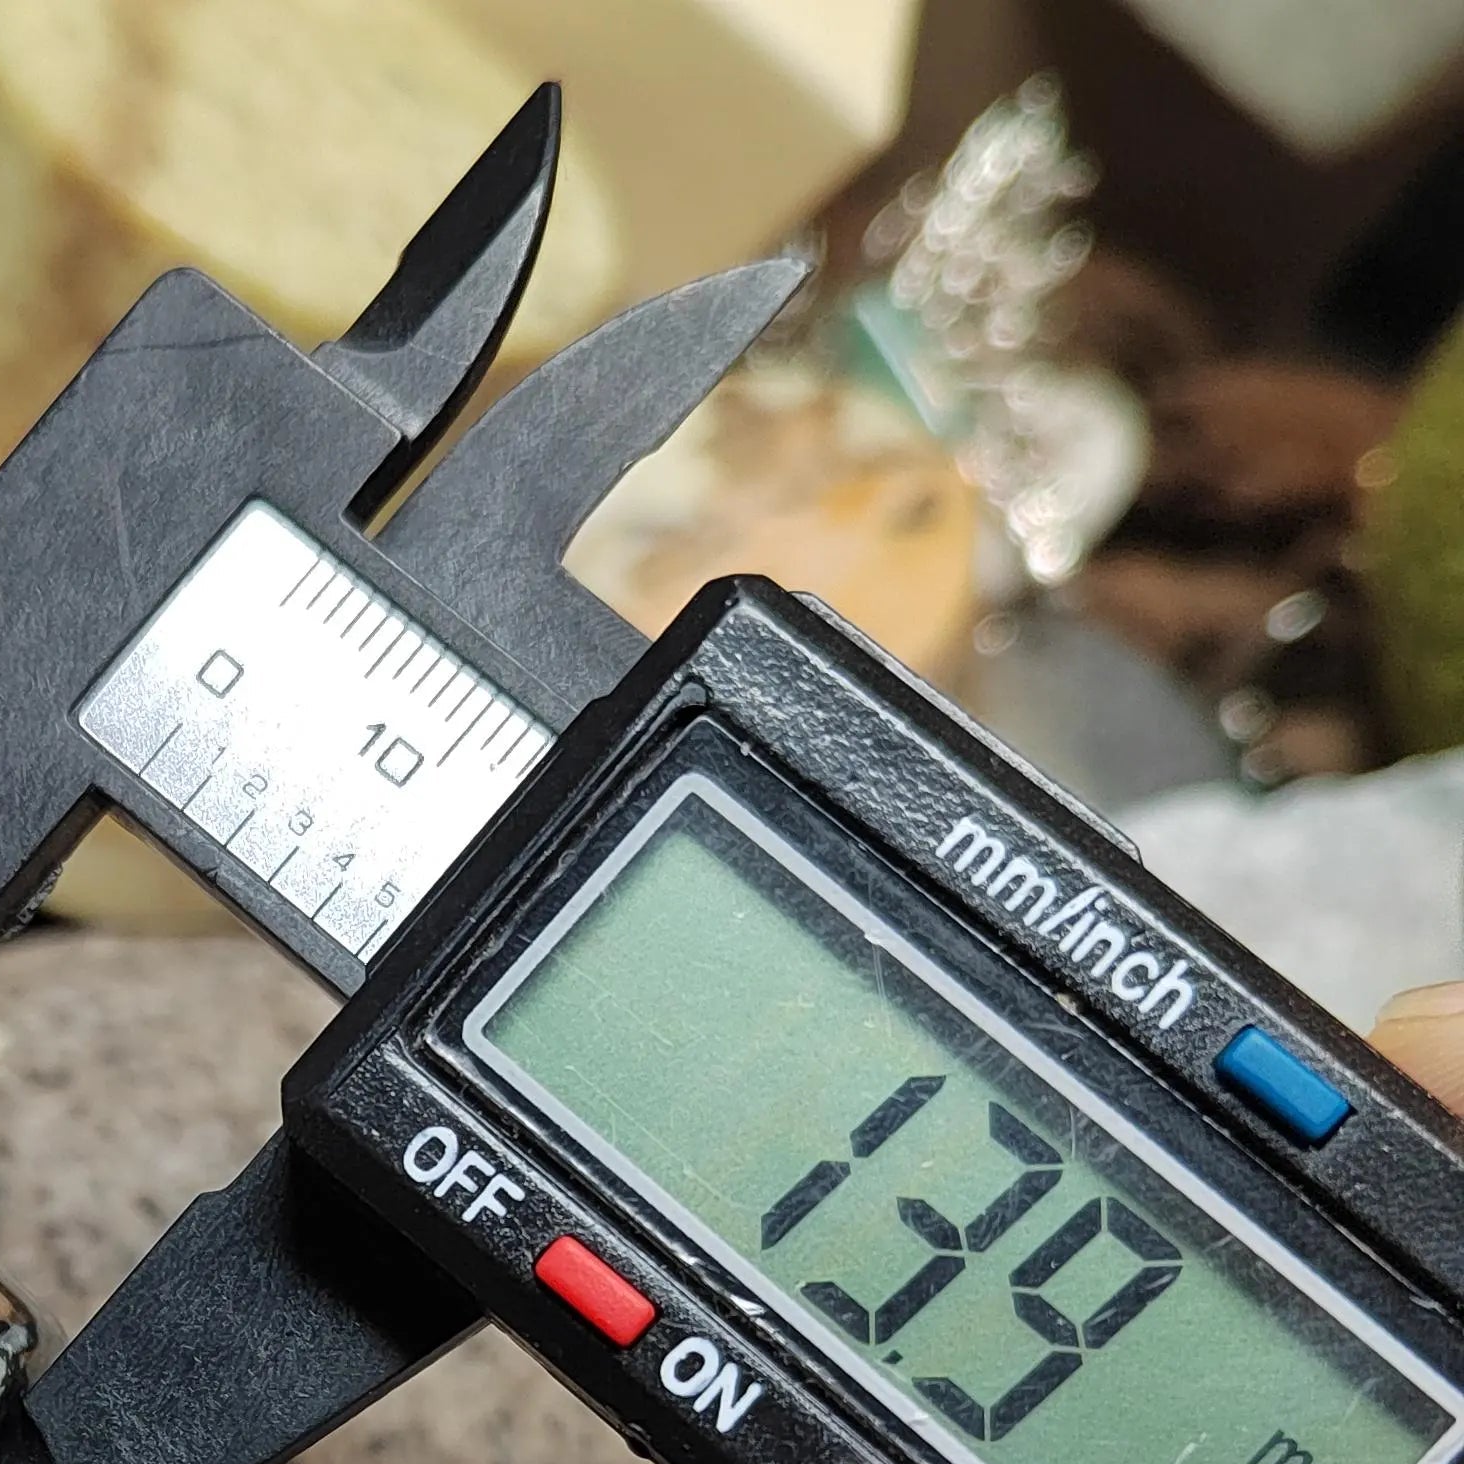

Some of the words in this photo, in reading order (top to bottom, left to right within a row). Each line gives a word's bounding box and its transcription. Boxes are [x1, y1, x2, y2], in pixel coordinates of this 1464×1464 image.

[197, 649, 244, 698] 0
[359, 723, 424, 788] 10
[212, 747, 226, 765] 1
[243, 774, 268, 800] 2
[288, 810, 314, 836] 3
[332, 853, 356, 871] 4
[375, 882, 401, 908] 5
[936, 815, 1195, 1029] mm/inch
[401, 1125, 525, 1223] OFF
[761, 1074, 1183, 1442] 13.9
[660, 1336, 762, 1433] ON
